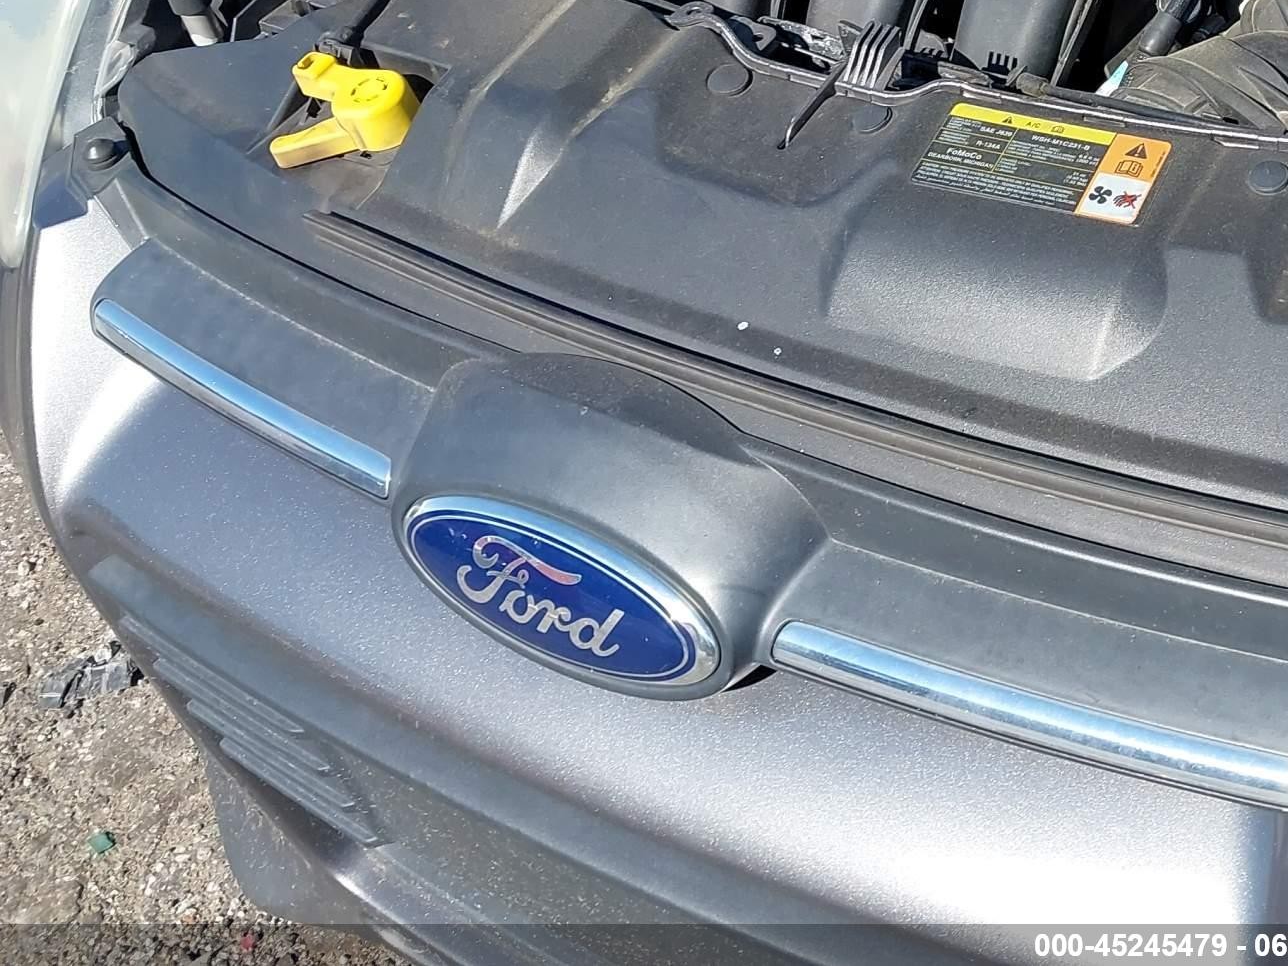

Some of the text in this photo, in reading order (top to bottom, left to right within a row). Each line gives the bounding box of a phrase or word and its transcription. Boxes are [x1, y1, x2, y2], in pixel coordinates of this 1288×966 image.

[1025, 121, 1042, 129] A/C
[975, 140, 1001, 150] R-134A
[946, 147, 983, 160] FoMoCo
[457, 536, 625, 657] Ford
